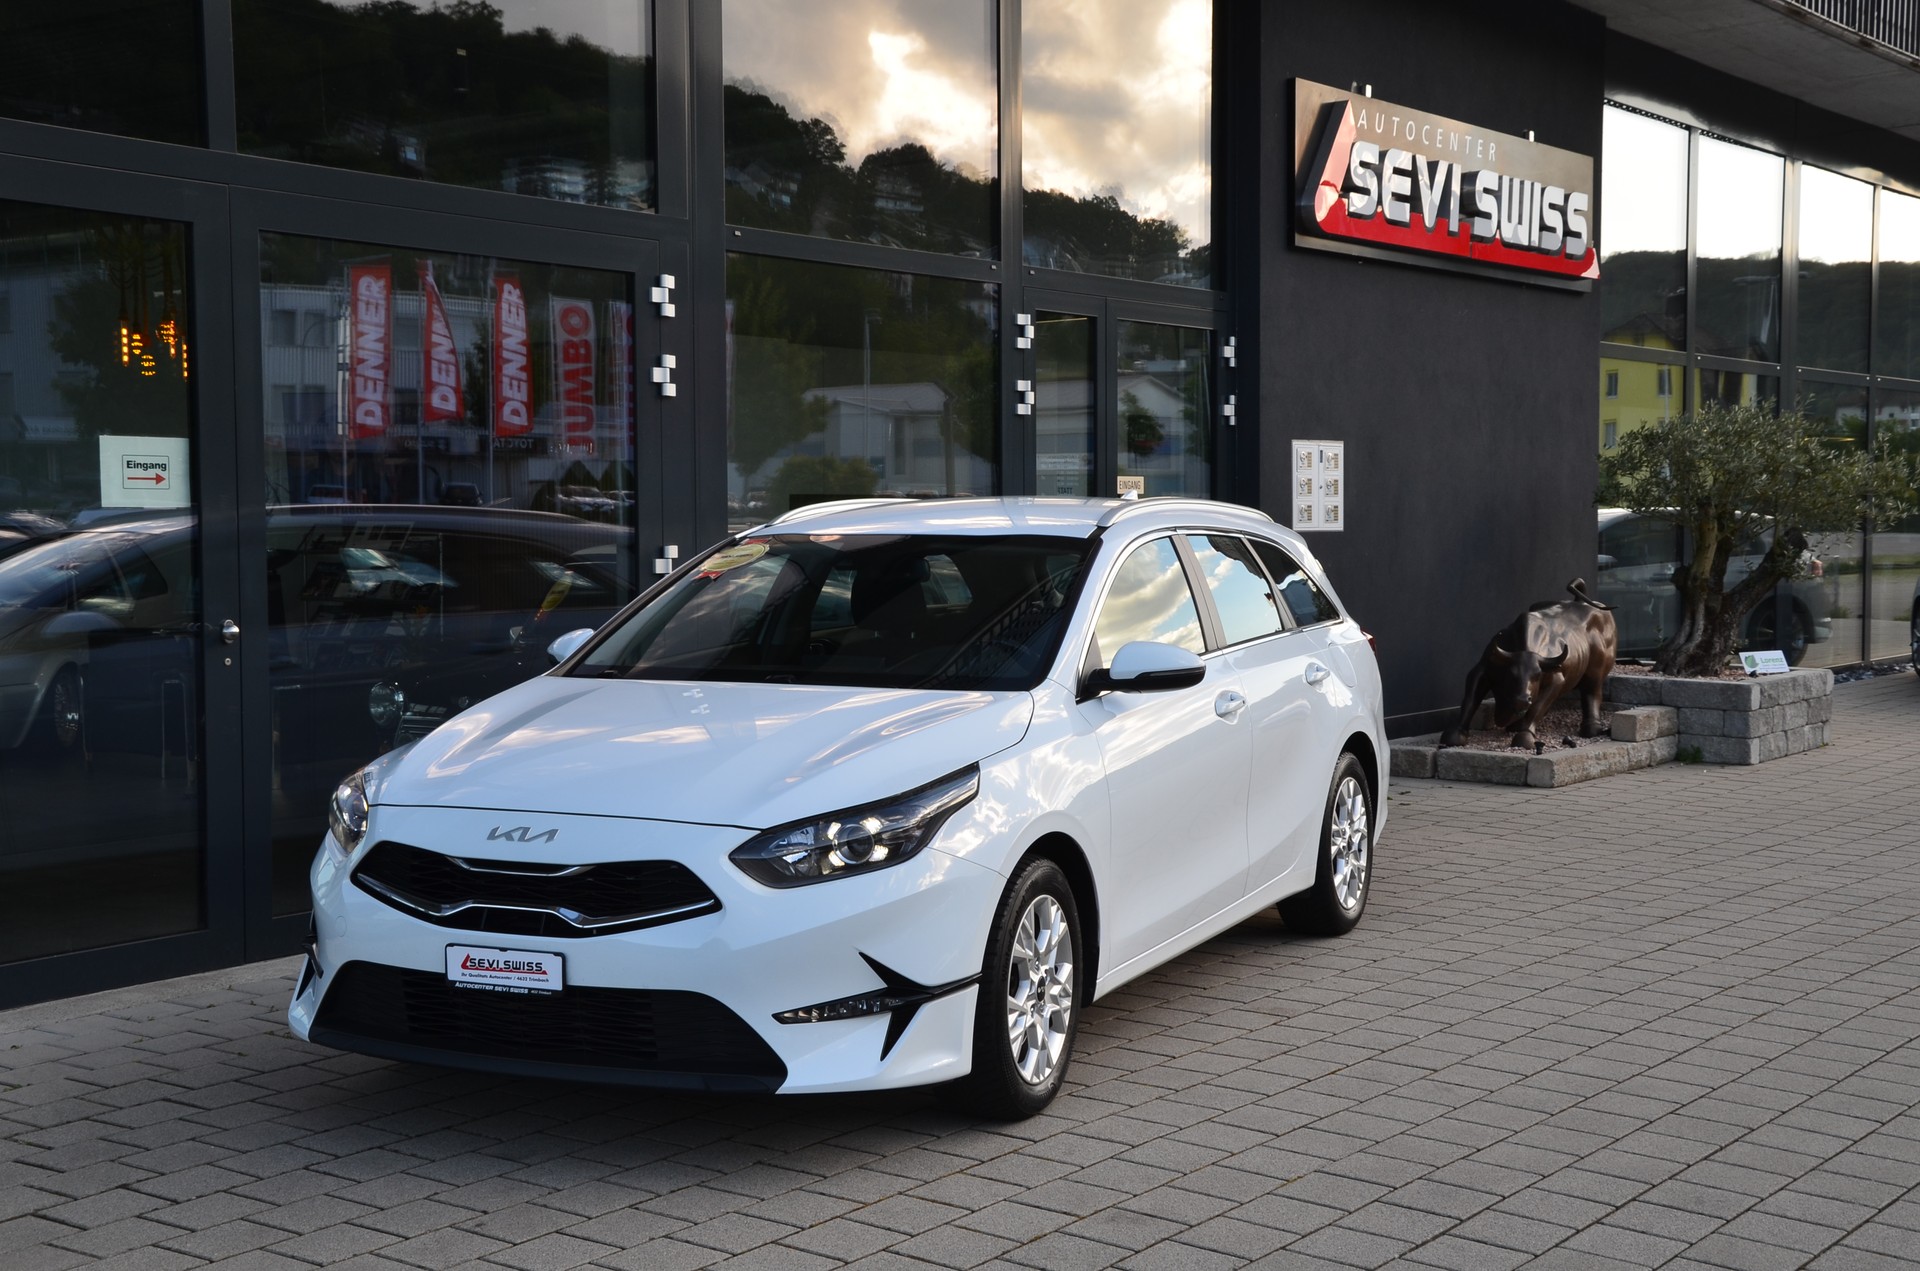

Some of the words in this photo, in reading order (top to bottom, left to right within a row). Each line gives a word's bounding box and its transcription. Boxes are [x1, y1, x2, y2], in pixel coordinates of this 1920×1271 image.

[1357, 108, 1497, 162] AUTOCENTER
[1348, 141, 1462, 235] SEVI
[1473, 169, 1589, 260] SWISS
[356, 274, 387, 426] DENNER
[502, 282, 529, 426] DENNER
[559, 304, 595, 455] JUMBO
[126, 460, 167, 472] Eingang
[1119, 480, 1141, 490] EINGANG
[469, 958, 499, 970] SEVI
[503, 960, 543, 972] SWISS
